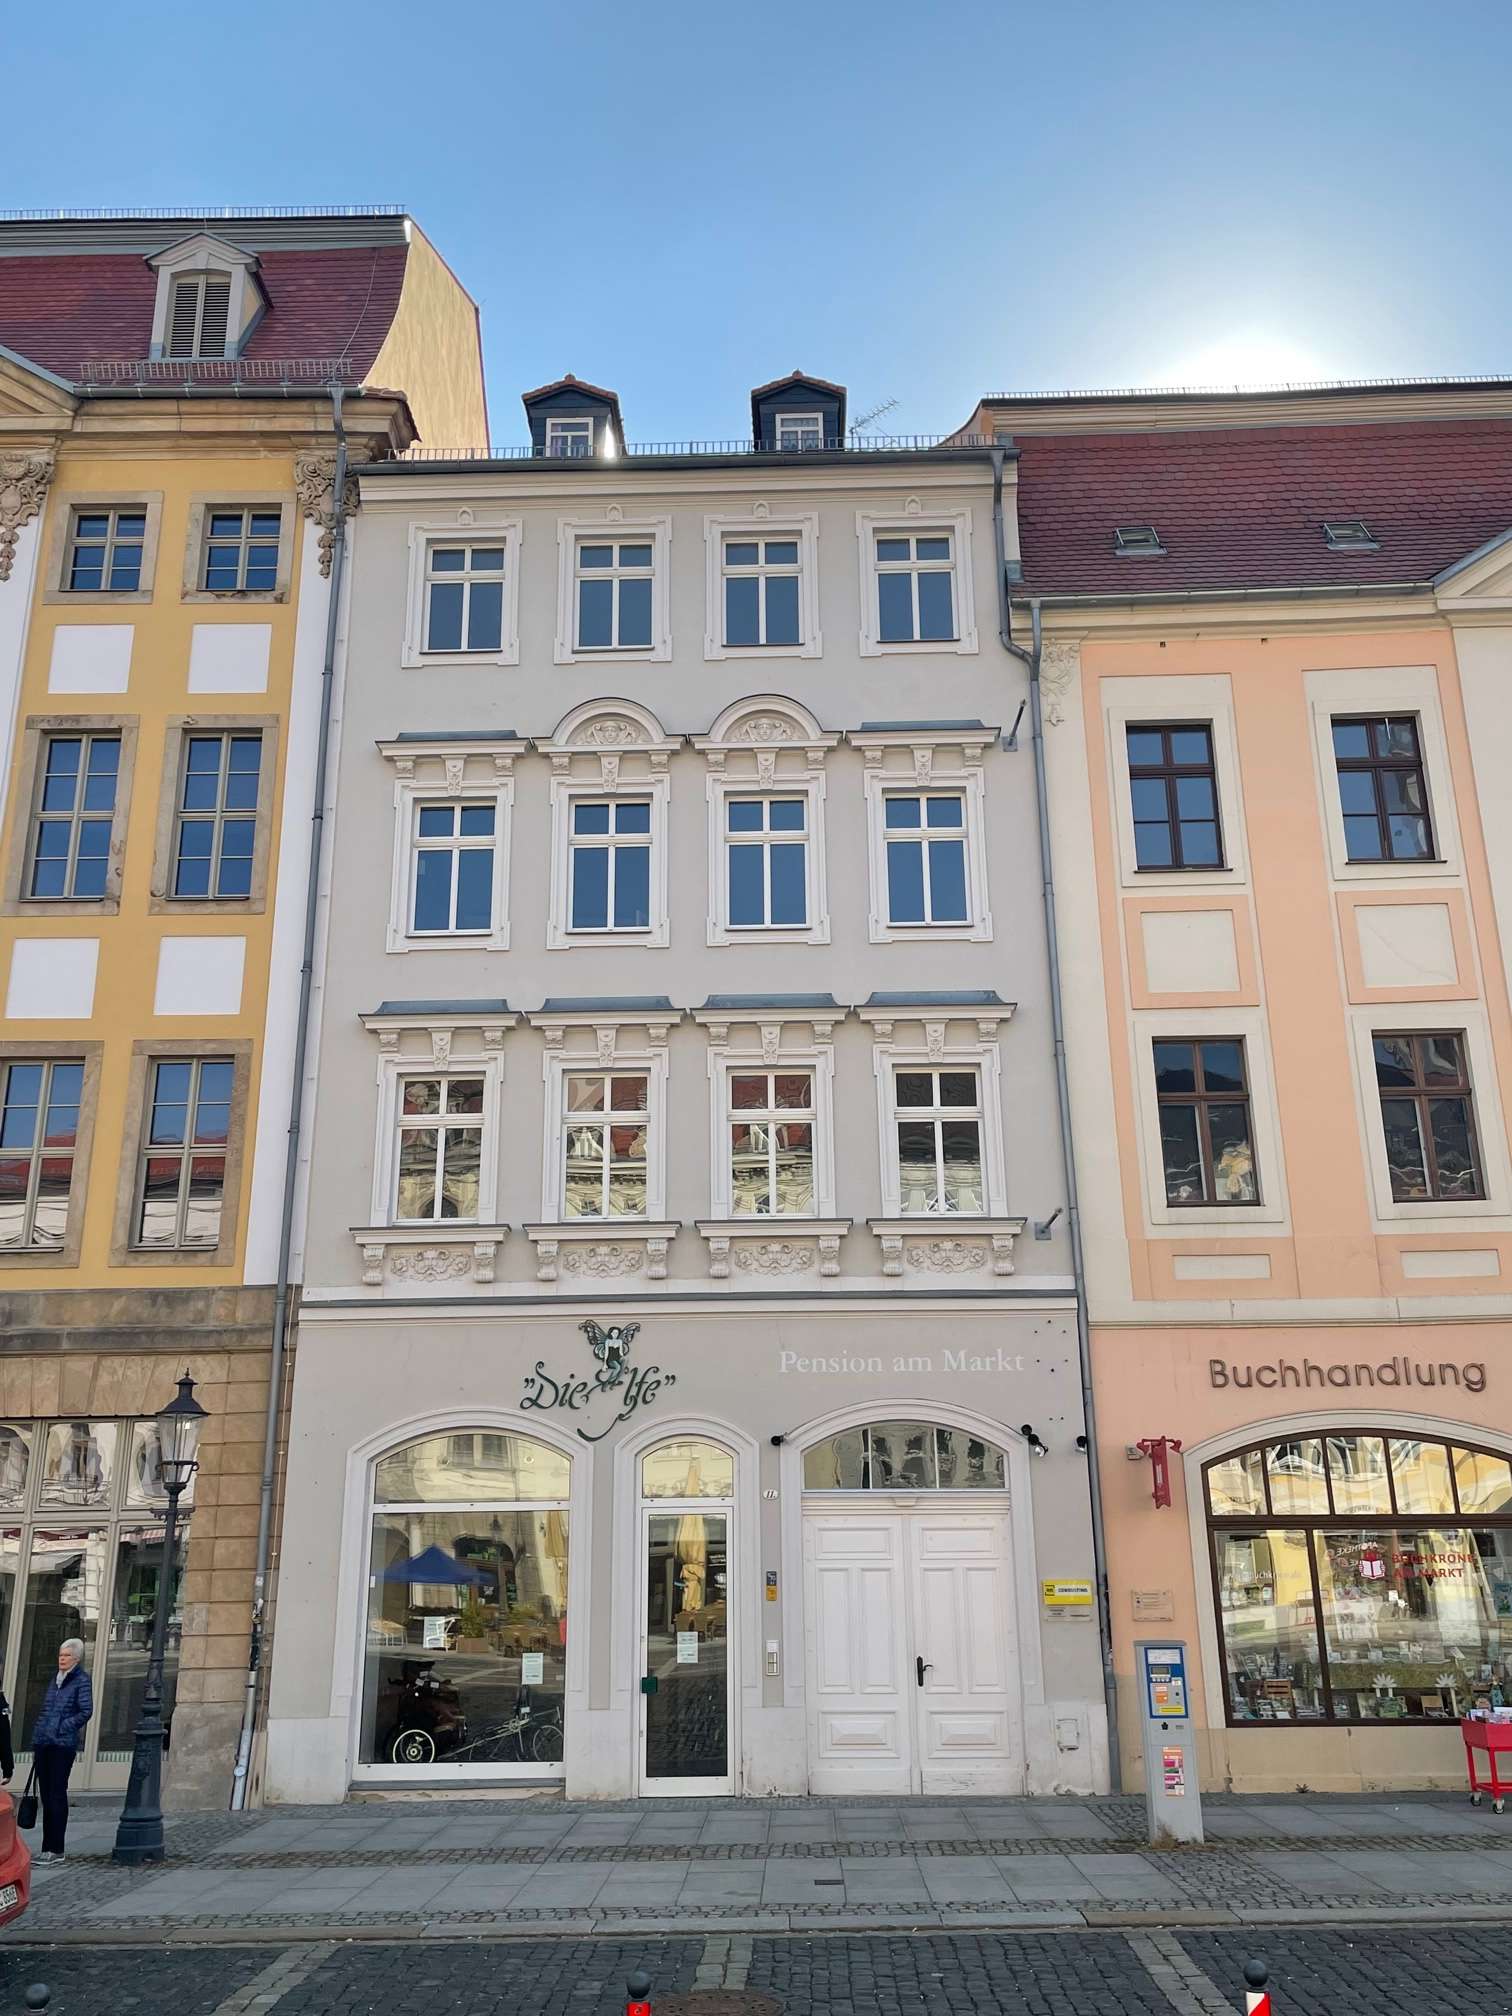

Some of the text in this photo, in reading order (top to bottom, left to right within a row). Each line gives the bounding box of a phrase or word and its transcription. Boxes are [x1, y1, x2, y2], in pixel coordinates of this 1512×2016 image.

[778, 1348, 1024, 1373] Pension am Markt
[1209, 1356, 1487, 1393] Buchhandlung
[1418, 1568, 1464, 1578] MARKT
